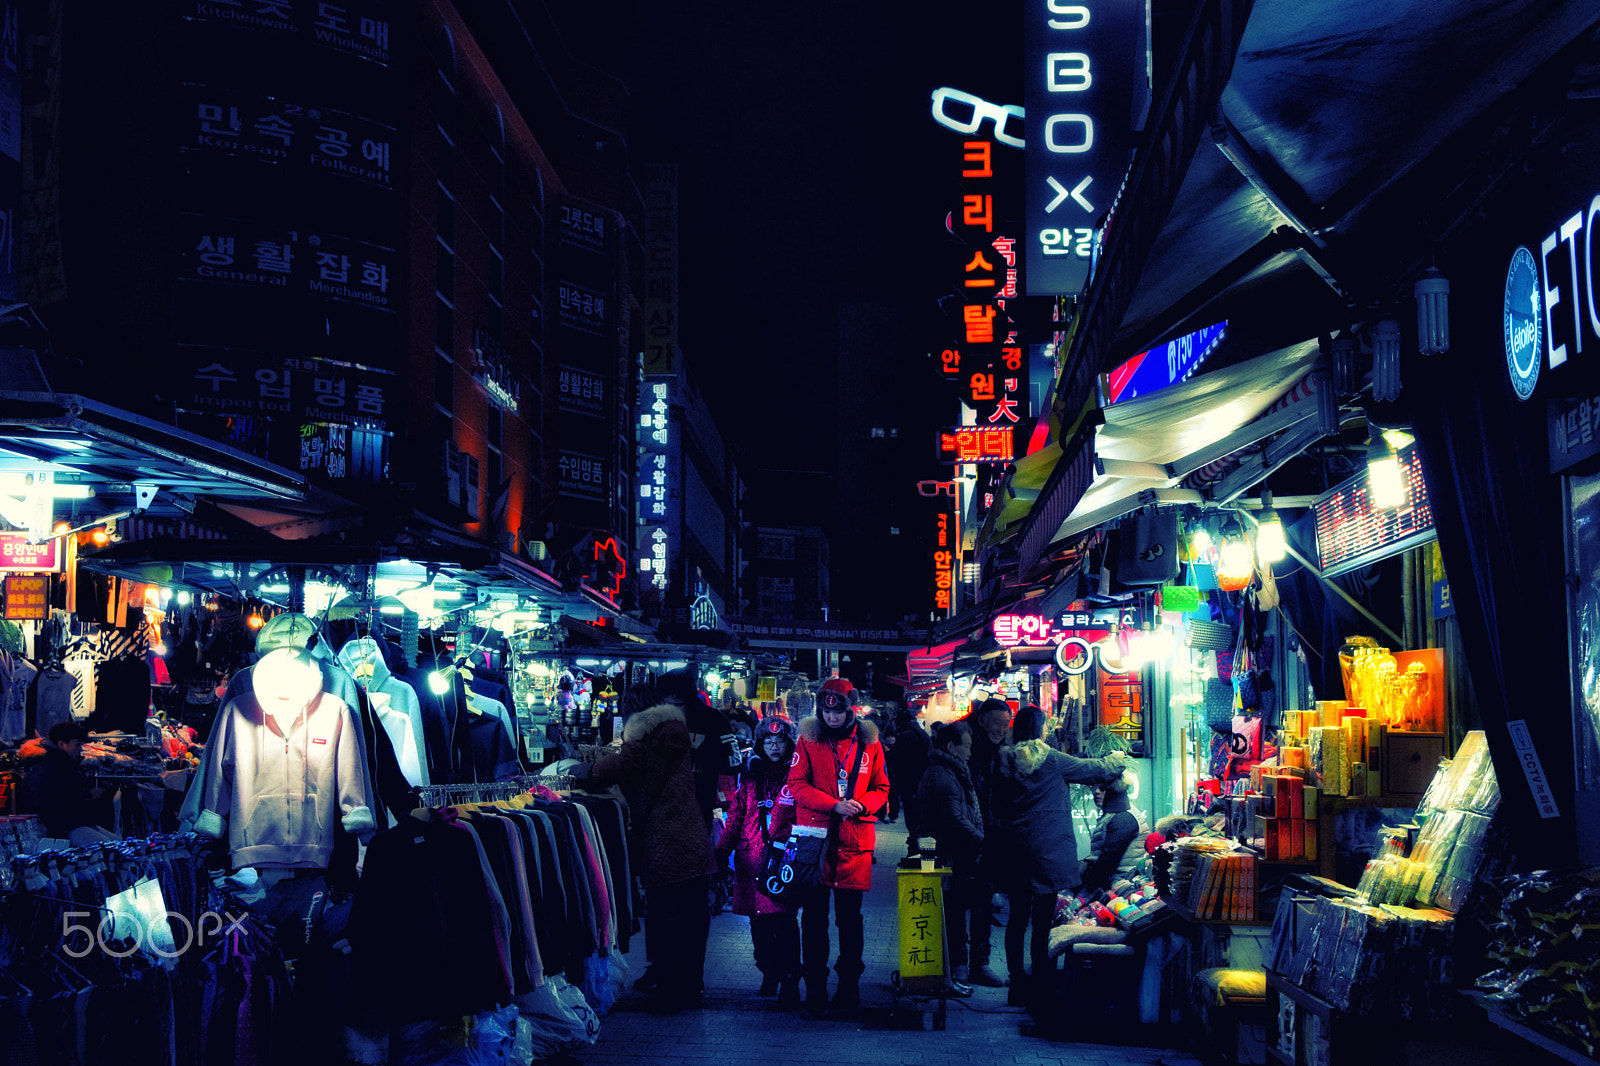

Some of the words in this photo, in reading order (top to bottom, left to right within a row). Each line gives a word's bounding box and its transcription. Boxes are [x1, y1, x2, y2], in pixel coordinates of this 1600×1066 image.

[198, 3, 298, 32] Kitchenware
[314, 28, 388, 61] Wholesale
[199, 134, 288, 158] Korean
[310, 154, 390, 184] Folkcraft
[197, 265, 287, 287] General
[309, 279, 388, 305] Merchandise
[560, 286, 604, 320] 민속공예
[559, 371, 603, 401] 생활잡화
[194, 393, 291, 413] Imported
[305, 406, 387, 431] Merchandise
[652, 383, 668, 444] 민속공예
[558, 455, 603, 484] 수입명품
[653, 454, 667, 515] 생활잡화
[11, 579, 44, 591] K-POP
[933, 550, 953, 610] 안경원
[1523, 753, 1543, 783] CCTV
[908, 887, 938, 967] 楓京社
